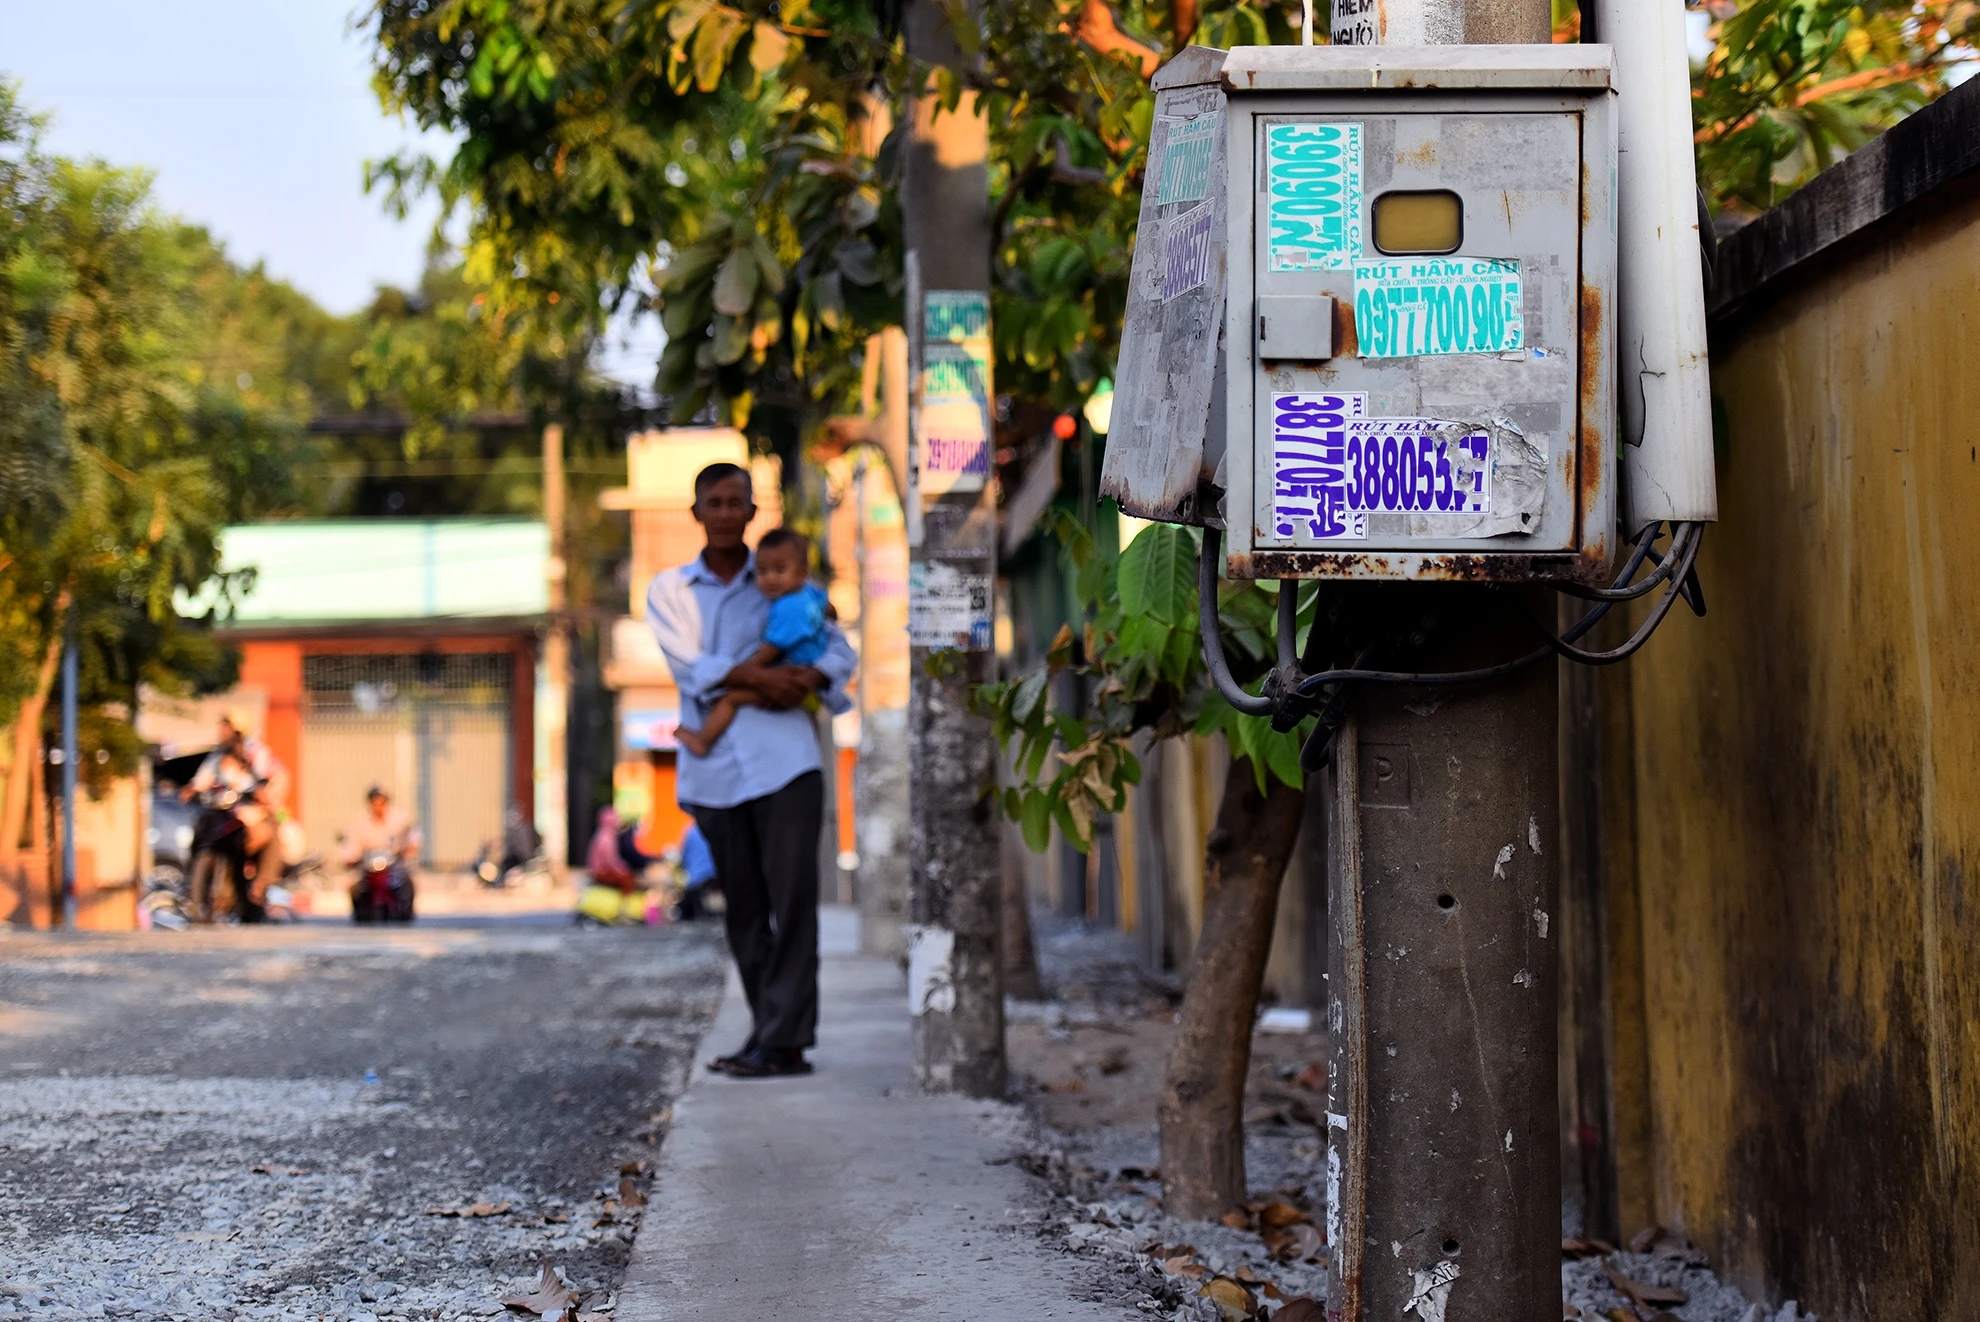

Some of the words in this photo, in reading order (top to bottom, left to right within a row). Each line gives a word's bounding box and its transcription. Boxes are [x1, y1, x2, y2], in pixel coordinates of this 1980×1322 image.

[1349, 127, 1361, 166] RÚT
[1349, 172, 1361, 220] HẦM
[1356, 262, 1402, 280] RÚT
[1411, 260, 1464, 278] HẦM
[1471, 258, 1519, 276] CẦU
[1378, 278, 1391, 287] SỬA
[1393, 278, 1411, 286] CHỮA
[1350, 420, 1392, 431] RÚT
